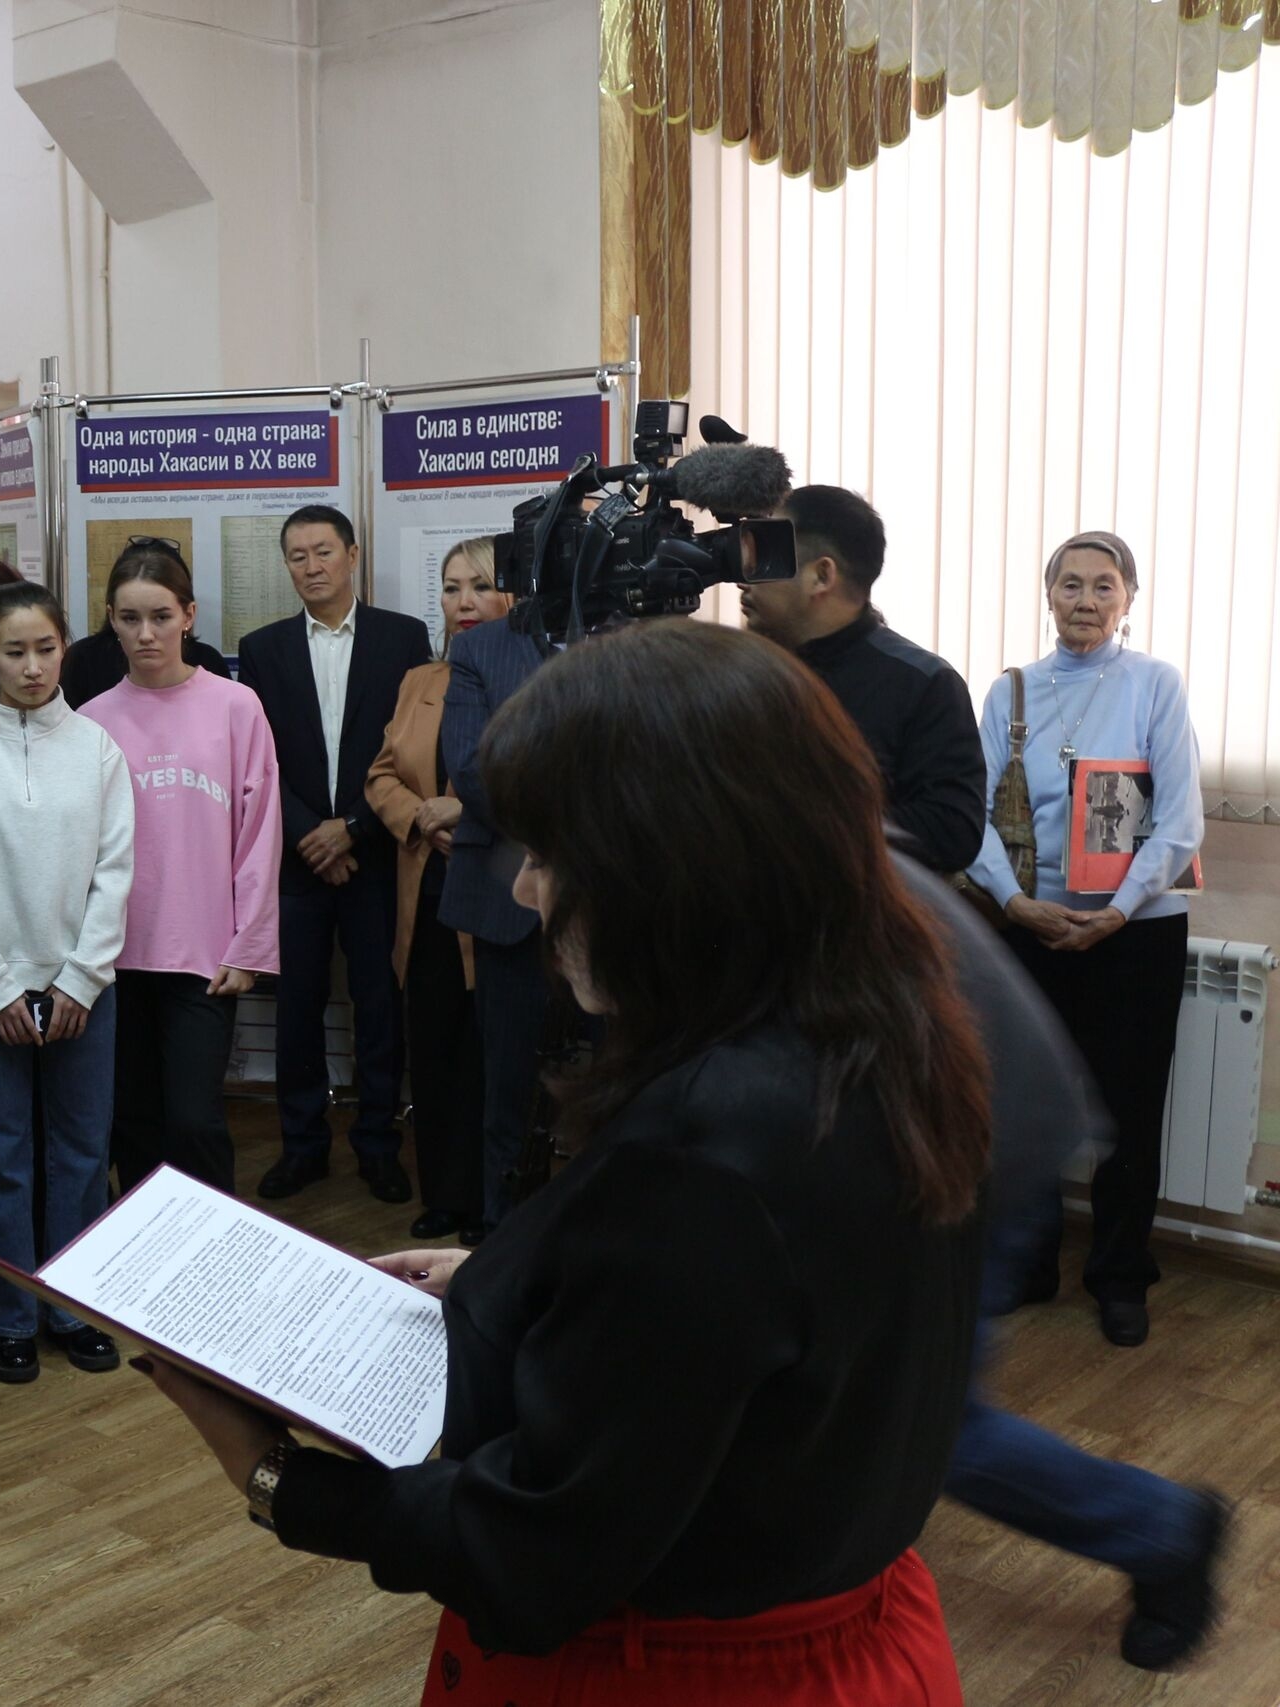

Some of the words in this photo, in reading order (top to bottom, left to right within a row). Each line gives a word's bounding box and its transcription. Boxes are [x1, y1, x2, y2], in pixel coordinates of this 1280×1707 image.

[81, 427, 124, 450] Одна
[129, 428, 197, 448] история
[215, 426, 256, 445] одна
[262, 424, 326, 445] страна:
[416, 415, 457, 440] Сила
[462, 417, 472, 437] в
[477, 409, 563, 438] единстве:
[89, 457, 154, 478] народы
[159, 452, 229, 473] Хакасии
[235, 455, 244, 470] в
[277, 452, 317, 469] веке
[418, 449, 485, 473] Хакасия
[490, 446, 560, 470] сегодня
[135, 767, 177, 790] YES
